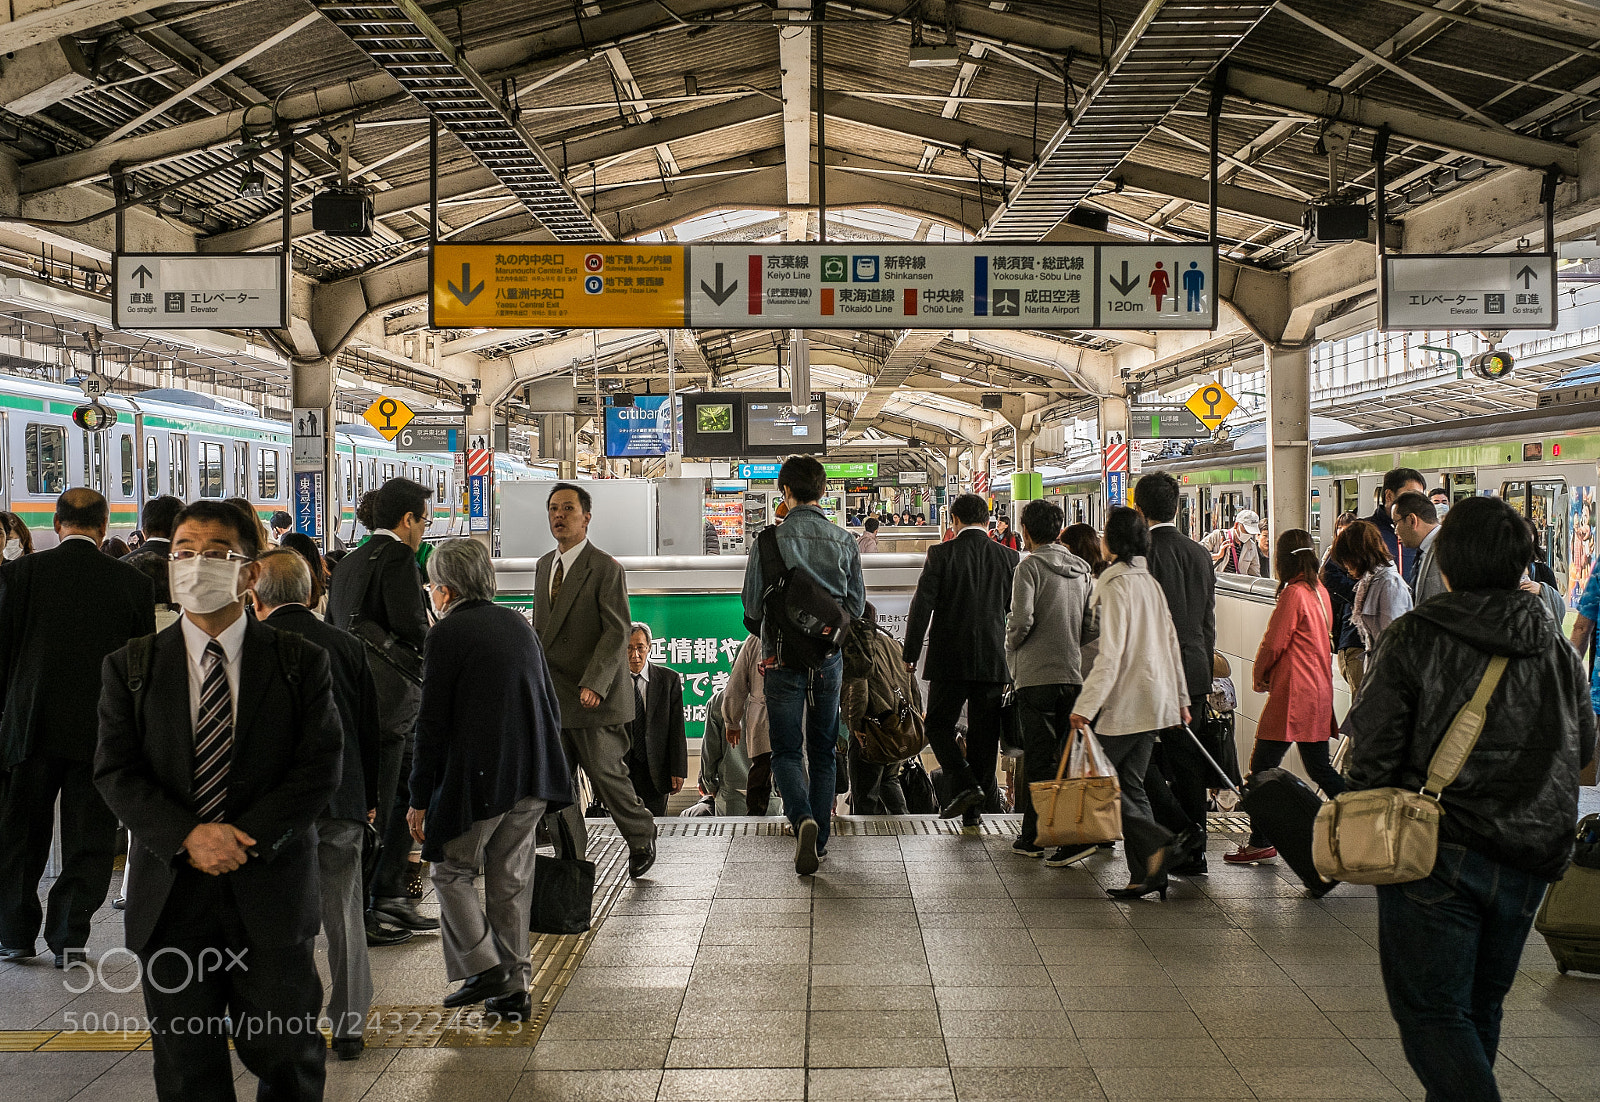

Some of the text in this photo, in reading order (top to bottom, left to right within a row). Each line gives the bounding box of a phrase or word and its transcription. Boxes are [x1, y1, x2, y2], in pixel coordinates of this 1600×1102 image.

[495, 254, 564, 266] 丸の内中央口
[605, 254, 672, 265] 地下鉄 丸ノ内線
[767, 255, 809, 269] 京葉線
[884, 256, 926, 270] 新幹線
[992, 256, 1085, 270] 横須賀・総武線
[605, 277, 664, 287] 地下鉄 東西線
[767, 271, 811, 281] Keiyō Line
[884, 272, 933, 280] Shinkansen
[1063, 272, 1082, 281] Line
[130, 292, 154, 304] 直進
[190, 292, 260, 304] エレベーター
[495, 287, 564, 300] 八重洲中央口
[839, 288, 895, 303] 東海道線
[922, 288, 965, 303] 中央線
[1024, 289, 1081, 304] 成田空港
[1408, 294, 1478, 305] エレベーター
[1515, 293, 1540, 305] 直進
[495, 301, 560, 309] Yaesu Central Exit
[839, 305, 893, 313] Tōkaidō Line
[922, 304, 964, 313] Chūō Line
[1024, 306, 1080, 315] Narita Airport
[1107, 301, 1144, 312] 120m
[1450, 307, 1478, 315] Elevator
[88, 380, 100, 393] 閉
[618, 408, 670, 419] citibank
[401, 429, 413, 447] 6
[743, 465, 751, 477] 6
[866, 464, 875, 476] 5
[472, 479, 481, 514] 東急ステイ
[299, 477, 311, 532] 東急ステイ
[875, 614, 908, 622] 用されて
